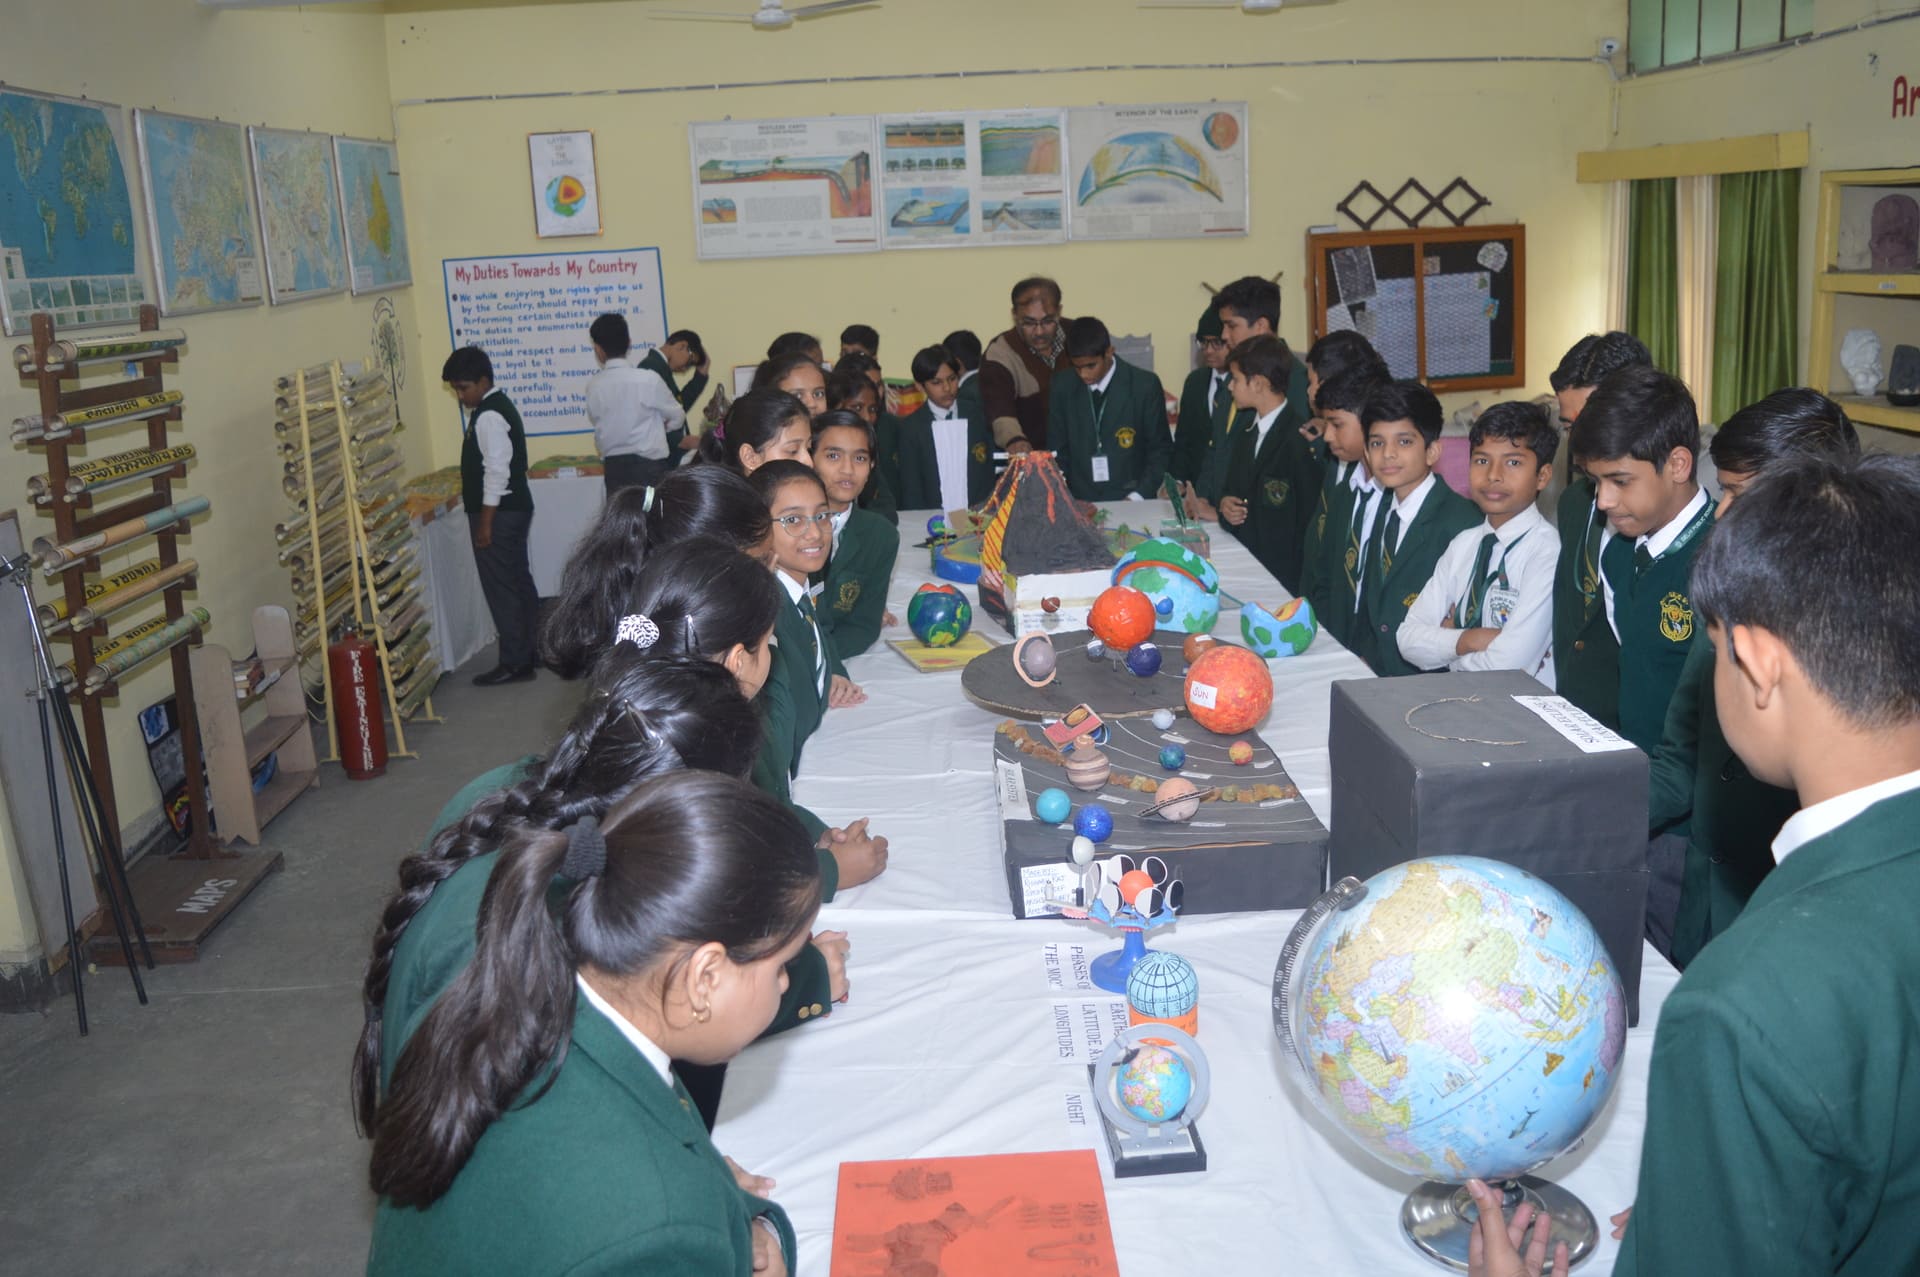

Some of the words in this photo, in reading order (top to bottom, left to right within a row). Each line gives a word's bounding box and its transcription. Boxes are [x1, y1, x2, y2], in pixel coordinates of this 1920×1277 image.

[455, 267, 471, 285] My
[473, 264, 509, 281] Duties
[511, 261, 561, 278] Towards
[567, 259, 583, 280] My
[588, 257, 638, 276] Country
[475, 292, 498, 301] while
[505, 288, 545, 302] enjoying
[549, 287, 563, 296] the
[567, 285, 591, 296] rights
[618, 283, 628, 291] to
[632, 283, 644, 291] us
[461, 305, 473, 316] by
[476, 304, 491, 312] the
[537, 299, 567, 309] should
[572, 298, 599, 308] repay
[605, 295, 612, 304] it
[618, 295, 630, 305] by
[518, 312, 552, 322] certain
[555, 310, 585, 319] duties
[463, 328, 481, 337] The
[485, 326, 513, 335] duties
[537, 322, 590, 332] enumerated
[517, 346, 555, 357] respect
[559, 345, 577, 354] and
[506, 360, 527, 370] loyal
[542, 370, 558, 378] the
[522, 395, 552, 405] should
[557, 395, 568, 404] be
[571, 393, 587, 402] the
[523, 406, 587, 418] accountability
[350, 650, 364, 683] FIRE
[1192, 687, 1209, 699] SUN
[175, 878, 238, 913] MAPS
[1045, 944, 1060, 966] THE
[1070, 945, 1089, 982] PHASES
[1054, 1004, 1075, 1058] LONGITUDES
[1082, 1004, 1103, 1046] LATITUDE
[1065, 1094, 1086, 1125] NIGHT
